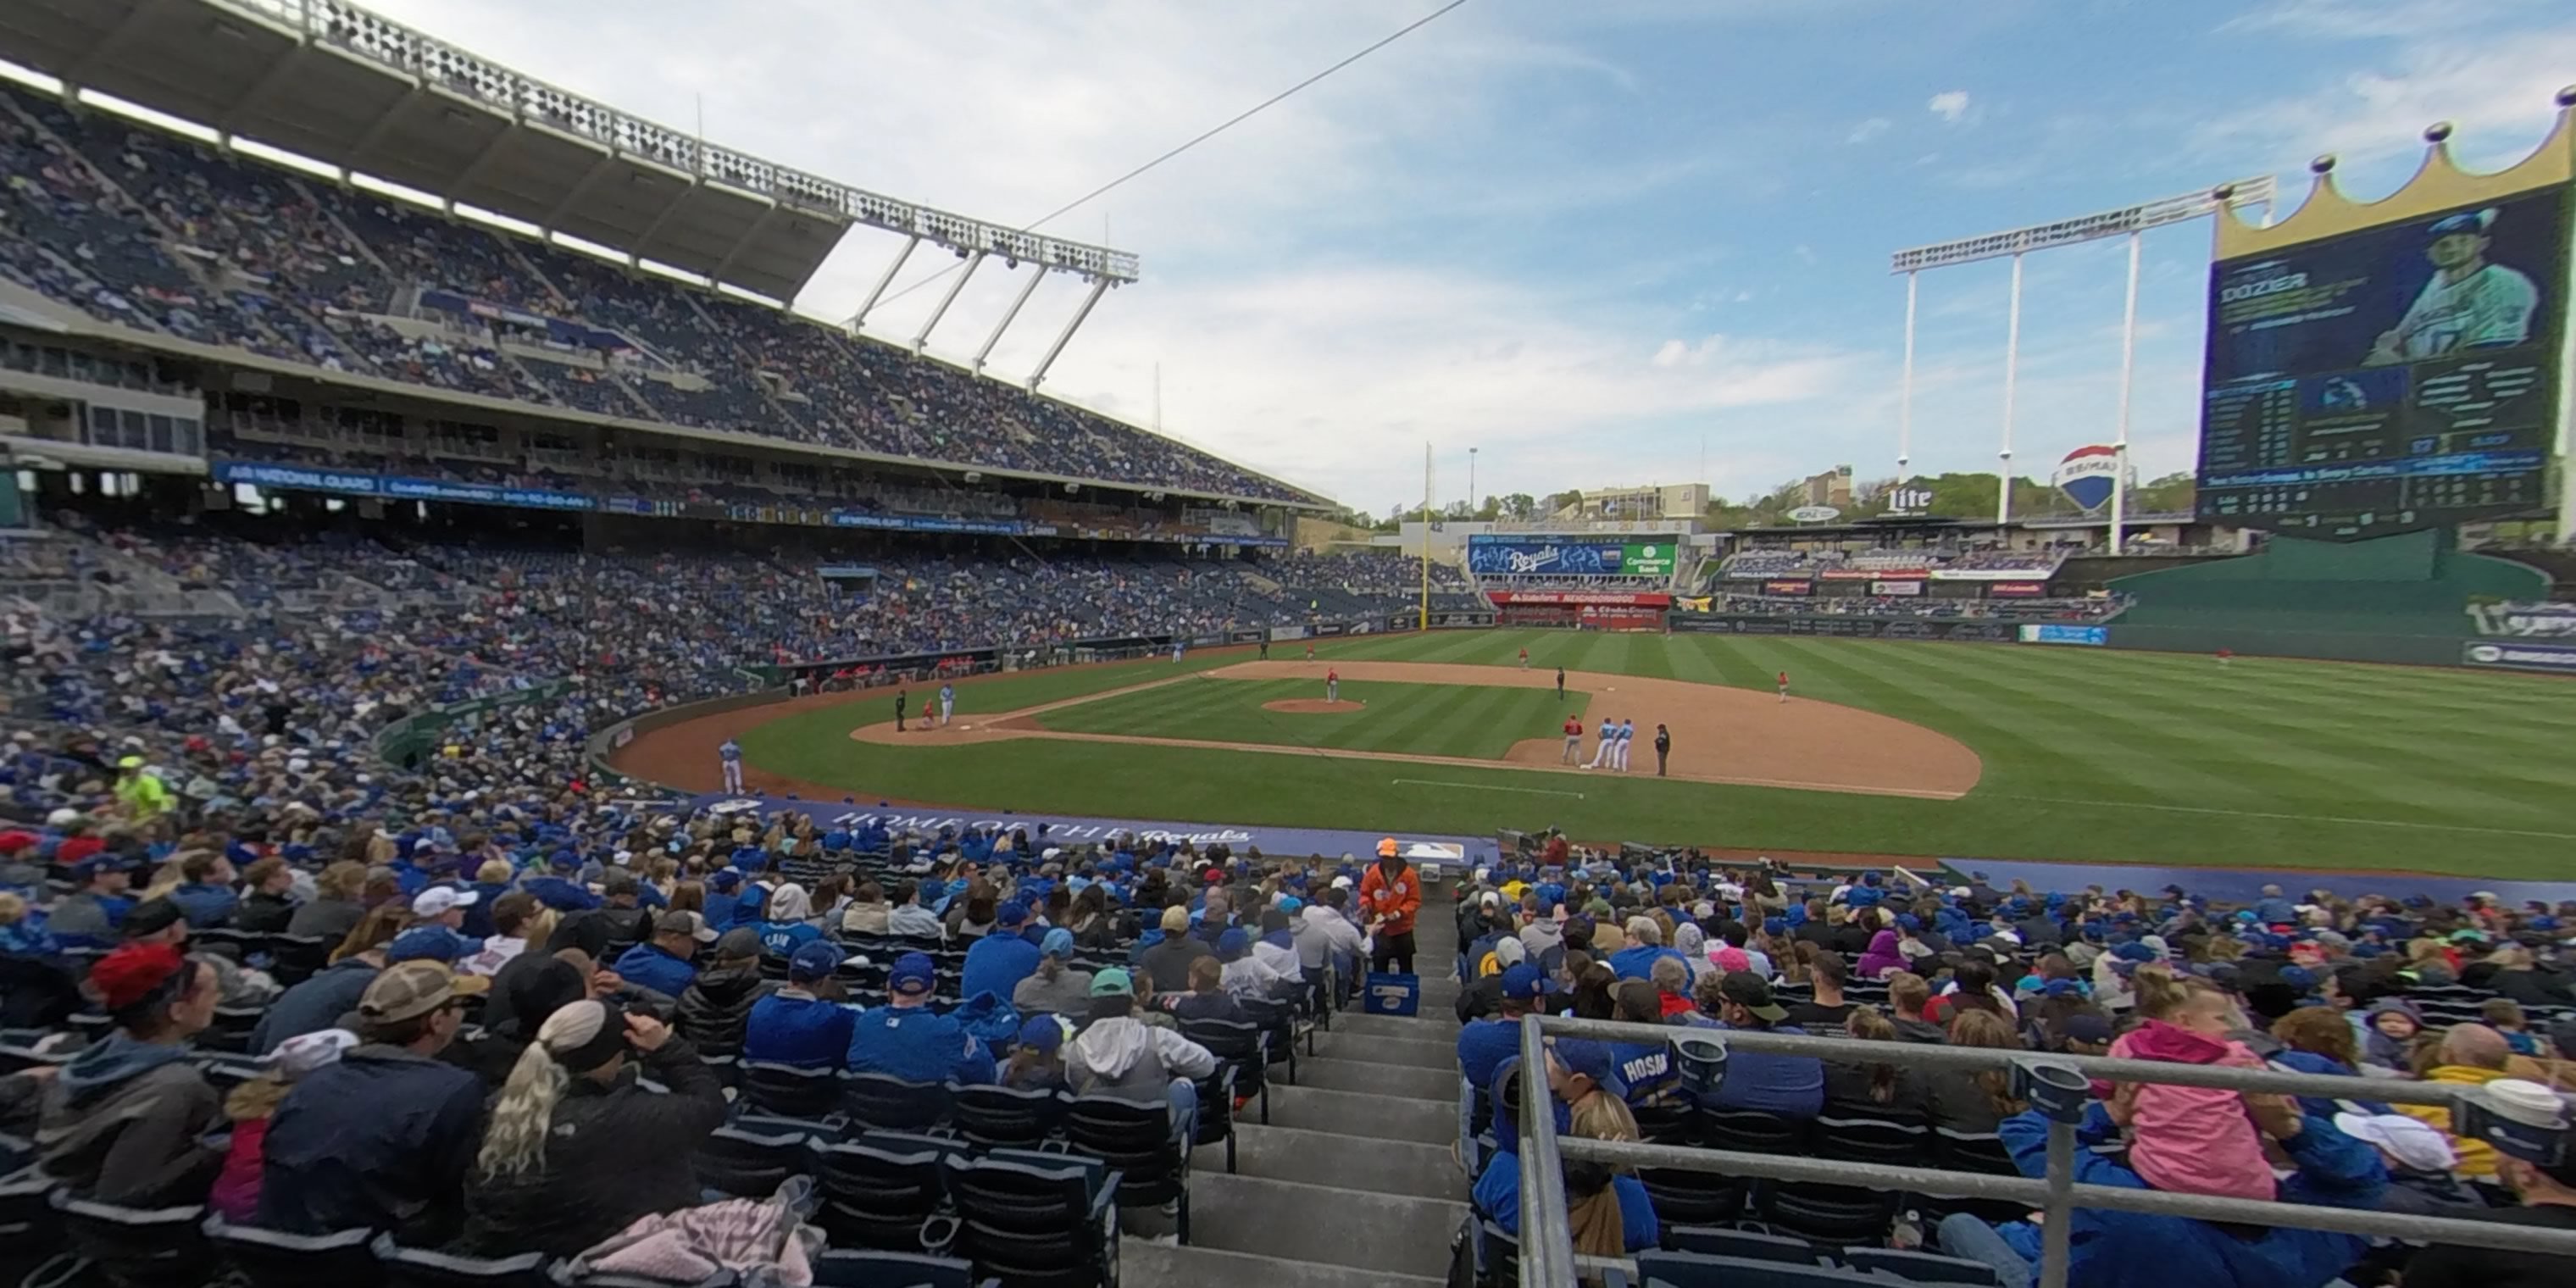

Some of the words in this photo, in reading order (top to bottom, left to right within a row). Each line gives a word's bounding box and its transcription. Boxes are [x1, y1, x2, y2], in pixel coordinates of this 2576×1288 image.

[2220, 272, 2308, 303] DOZIER
[255, 468, 322, 486] NATIONAL
[324, 475, 374, 490] GUARD
[1888, 488, 1933, 513] Lite
[1509, 545, 1559, 572] Royals
[1626, 557, 1671, 565] Commerce
[1637, 565, 1660, 574] Bank
[1563, 594, 1635, 602] NEIGHBORHOOD
[832, 812, 963, 830] HOME
[1046, 824, 1130, 840] THE
[1140, 829, 1255, 845] Royals
